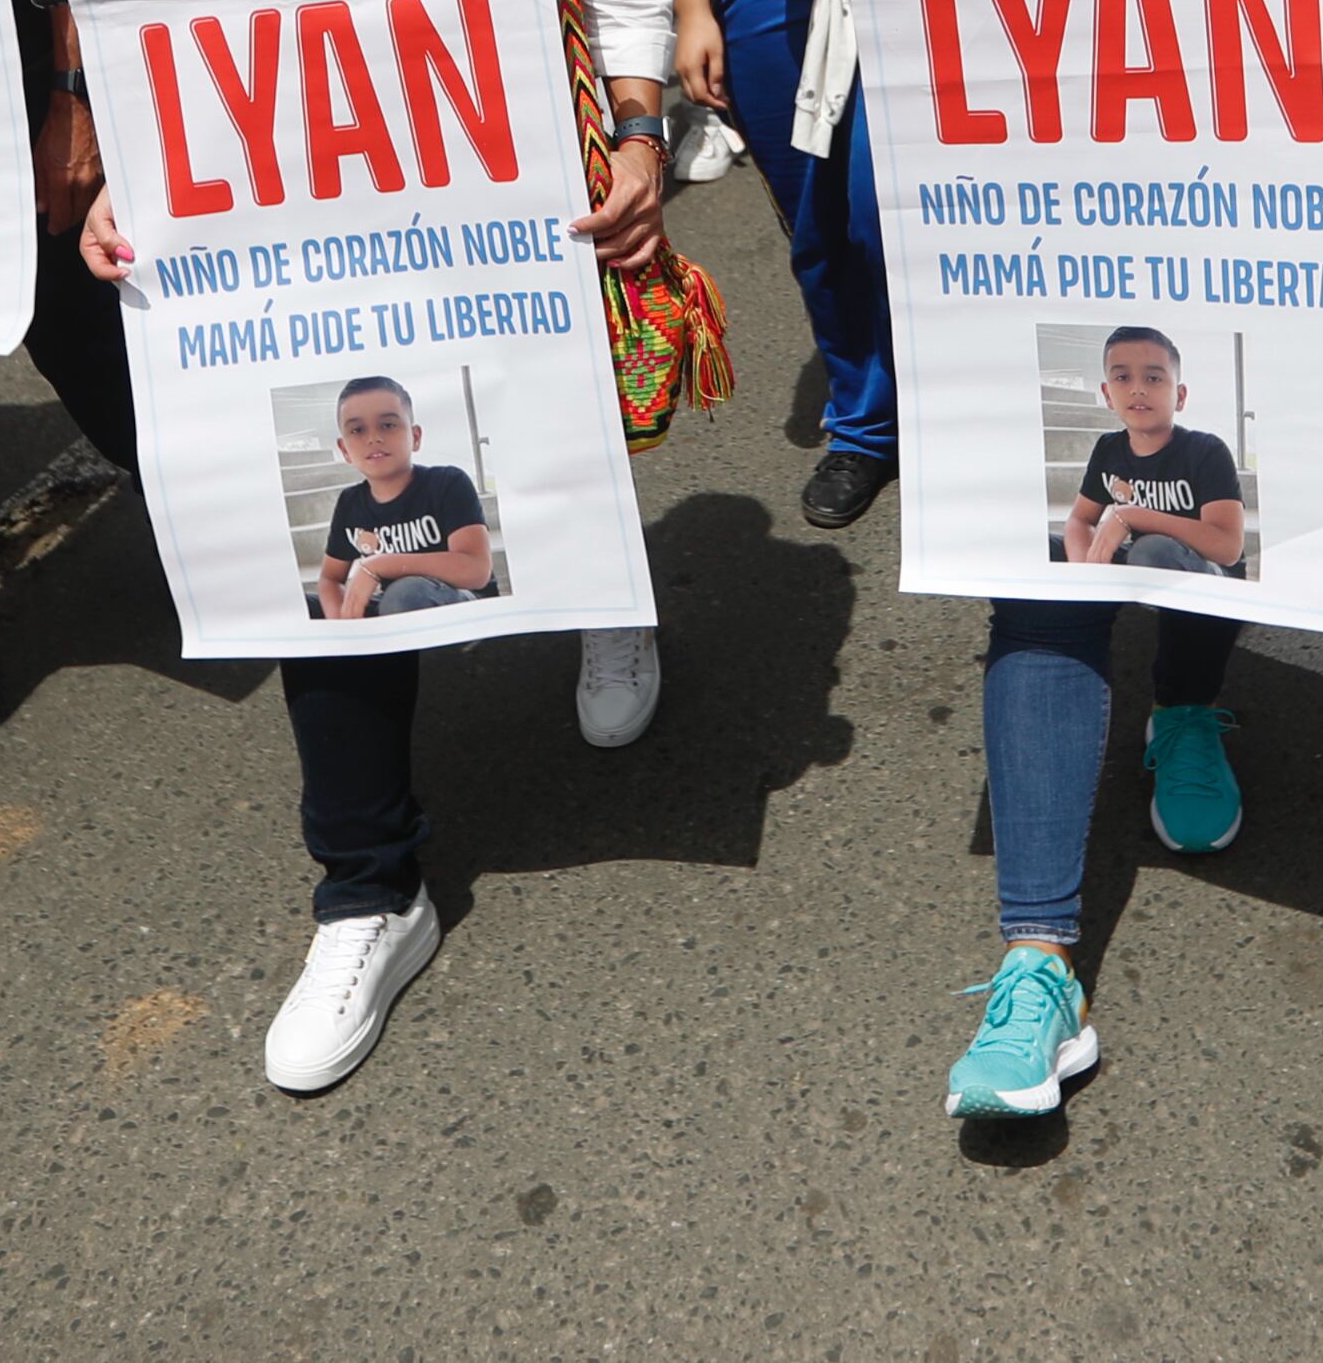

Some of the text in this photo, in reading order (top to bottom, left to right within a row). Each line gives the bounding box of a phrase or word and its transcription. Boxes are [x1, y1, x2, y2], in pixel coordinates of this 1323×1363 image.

[918, 175, 1007, 227] NIÑO
[1017, 181, 1062, 226] DE
[1073, 166, 1239, 229] CORAZÓN
[155, 213, 565, 299] NIÑO DE CORAZÓN NOBLE
[938, 236, 1048, 298] MAMÁ
[1058, 254, 1137, 301] PIDE
[1144, 256, 1191, 303] TU
[177, 290, 573, 370] MAMÁ PIDE TU LIBERTAD
